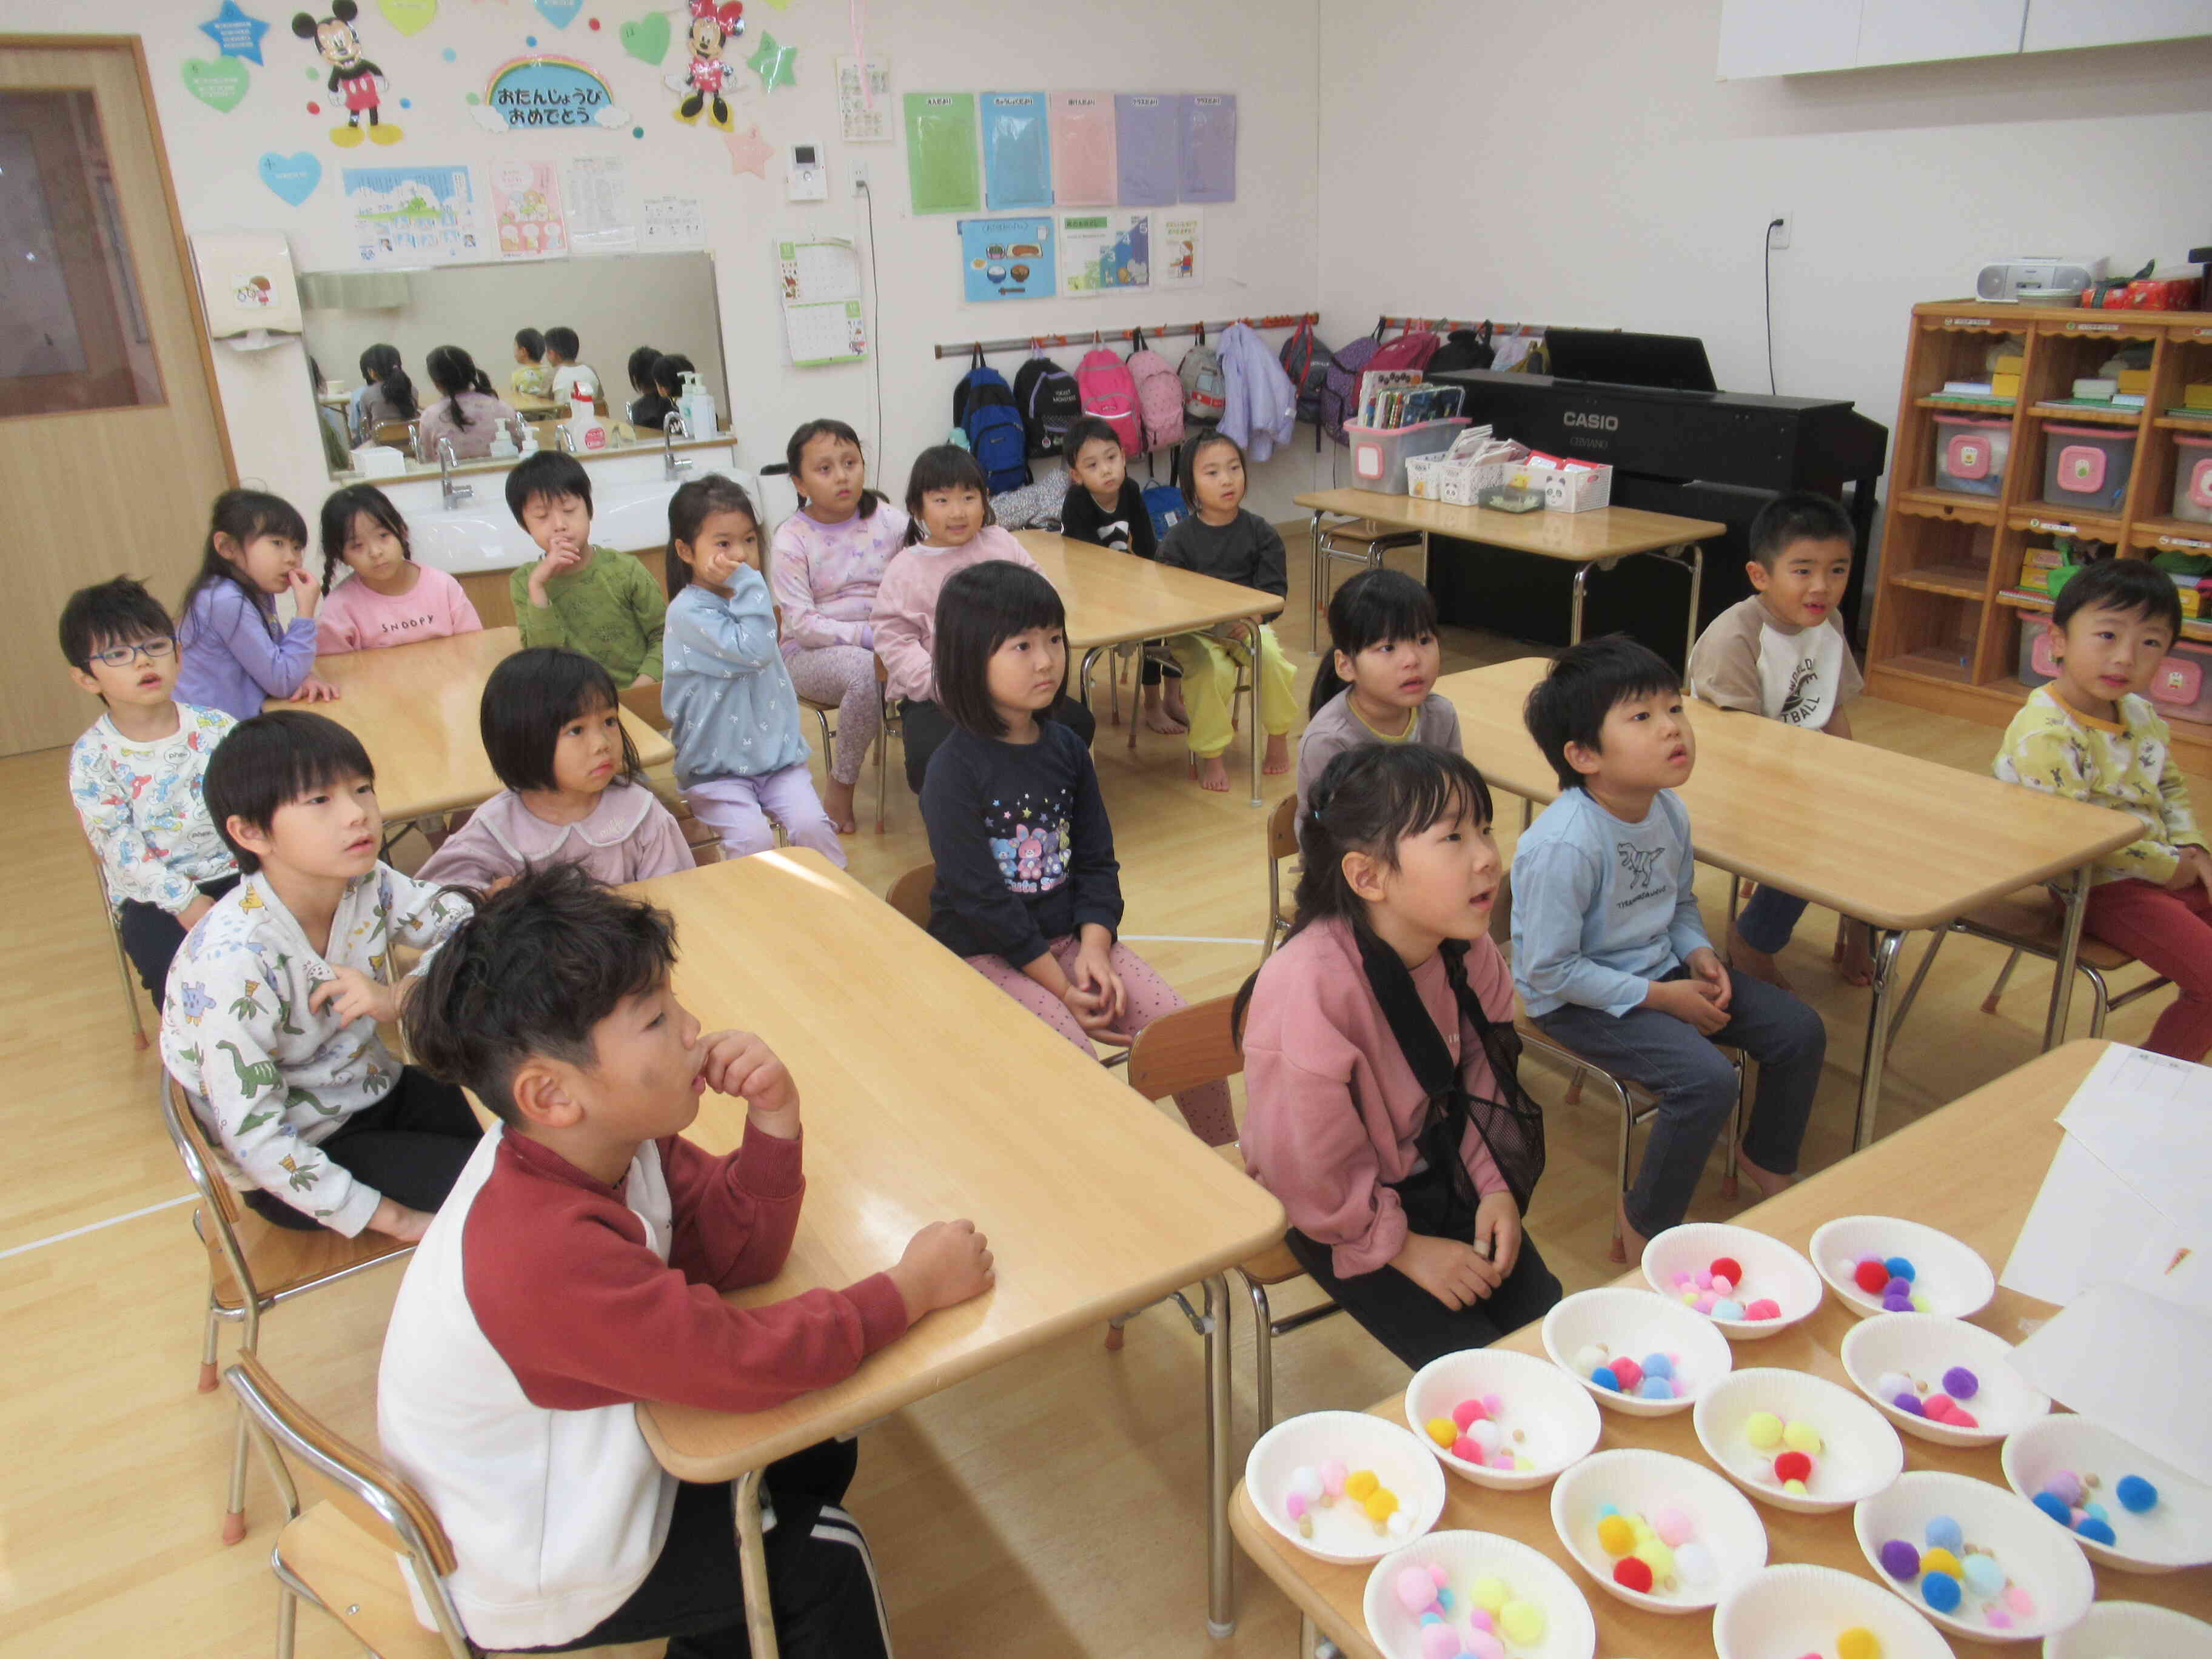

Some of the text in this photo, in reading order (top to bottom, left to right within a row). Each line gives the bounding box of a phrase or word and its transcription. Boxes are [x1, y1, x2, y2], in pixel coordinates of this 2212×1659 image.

[498, 89, 602, 105] おたんじょうび
[508, 107, 589, 125] おめでとう
[1564, 412, 1618, 431] CASIO
[381, 614, 434, 632] SNOOPY
